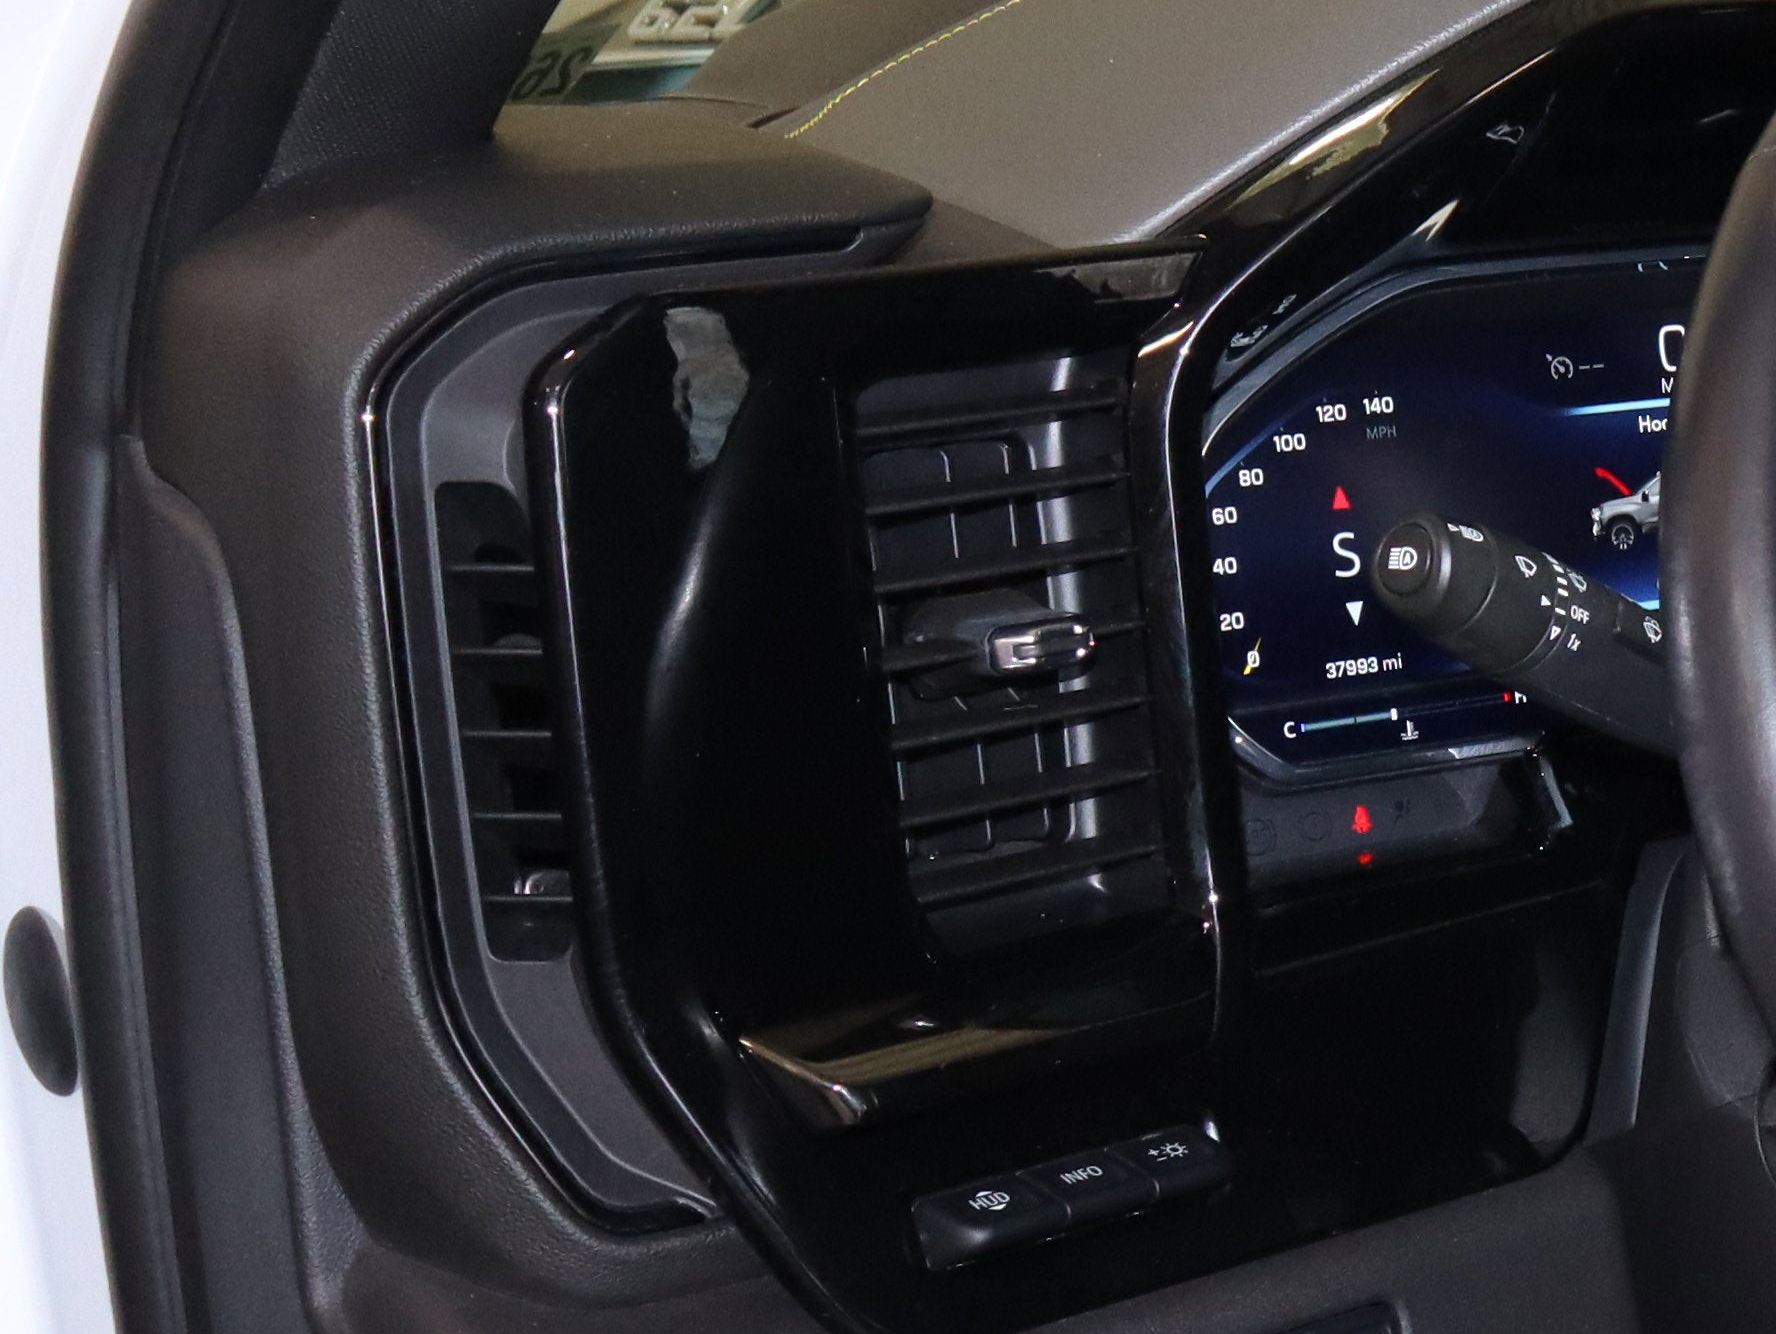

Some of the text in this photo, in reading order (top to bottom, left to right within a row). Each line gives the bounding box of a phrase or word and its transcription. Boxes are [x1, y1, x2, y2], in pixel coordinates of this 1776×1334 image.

[1315, 403, 1347, 423] 120
[1362, 395, 1394, 415] 140
[1365, 425, 1397, 440] MPH
[1272, 433, 1306, 453] 100
[1238, 468, 1264, 487] 80
[1212, 506, 1238, 525] 60
[1212, 556, 1237, 576] 40
[1220, 612, 1245, 631] 20
[1570, 605, 1590, 624] OFF
[1325, 652, 1403, 679] 37993 mi
[1283, 721, 1297, 739] C
[1059, 1166, 1104, 1185] INFO
[968, 1191, 1011, 1211] HUD
